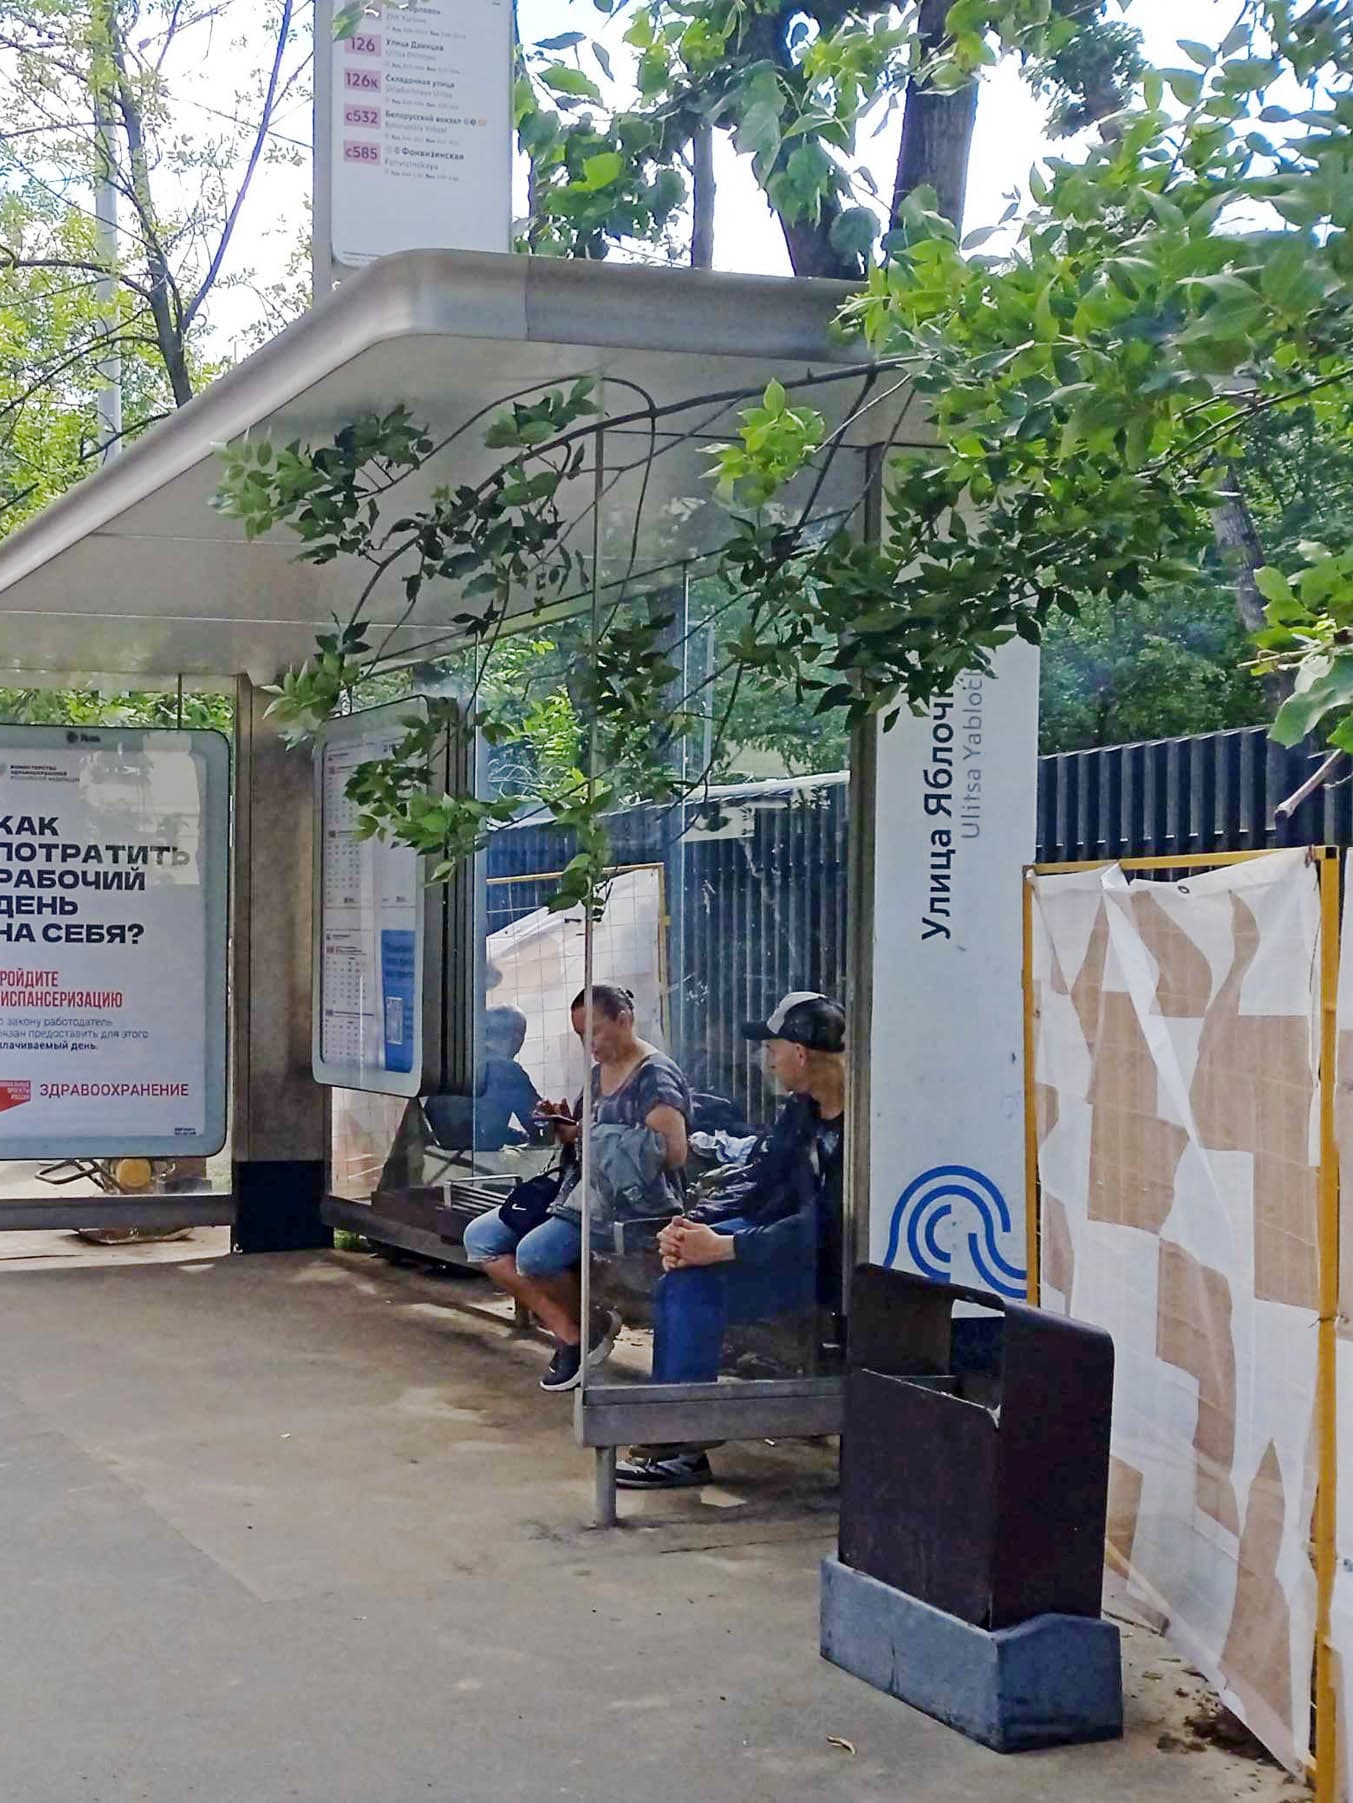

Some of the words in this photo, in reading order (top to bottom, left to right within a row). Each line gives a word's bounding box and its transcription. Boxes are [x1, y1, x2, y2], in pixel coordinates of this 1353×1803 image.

[351, 36, 376, 53] 126
[961, 767, 981, 839] Ulitsa
[921, 828, 956, 941] Улица
[42, 923, 145, 945] СЕБЯ?
[7, 1018, 41, 1028] закону
[43, 1016, 113, 1028] работодатель
[28, 1030, 98, 1040] предоставить
[100, 1031, 119, 1040] для
[122, 1031, 149, 1039] этого
[39, 1083, 189, 1099] ЗДРАВООХРАНЕНИЕ
